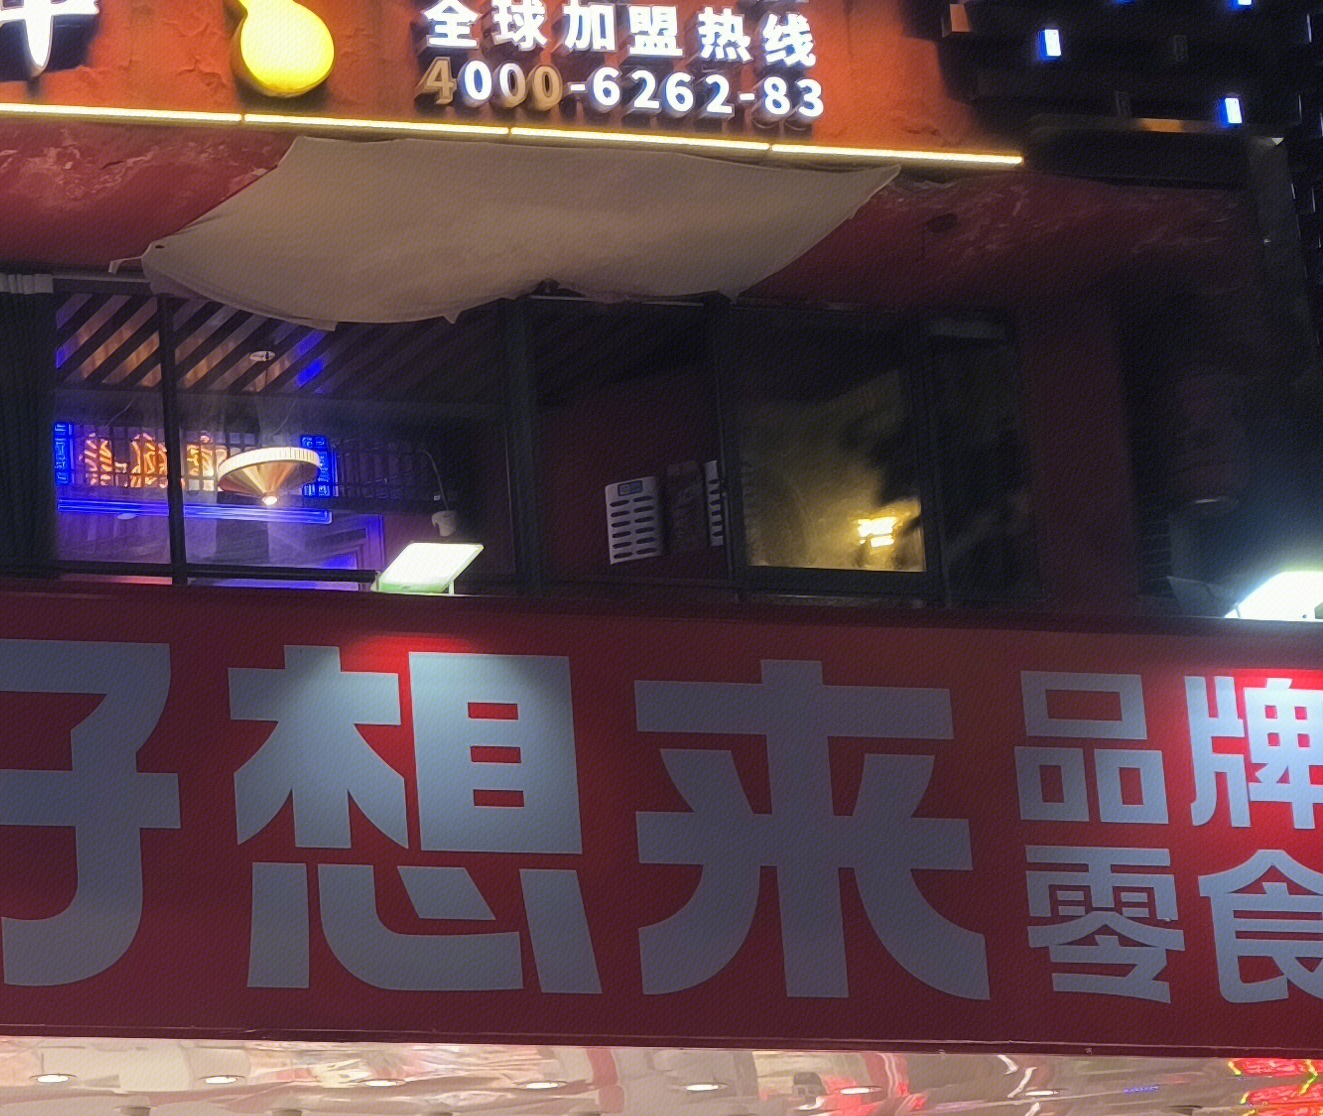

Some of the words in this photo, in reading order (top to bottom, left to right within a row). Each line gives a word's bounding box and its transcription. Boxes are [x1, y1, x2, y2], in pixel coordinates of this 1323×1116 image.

[423, 0, 818, 67] 全球加盟热线
[424, 55, 824, 119] 4000-6262-83
[1015, 670, 1323, 830] 品牌
[1025, 845, 1323, 1003] 零食
